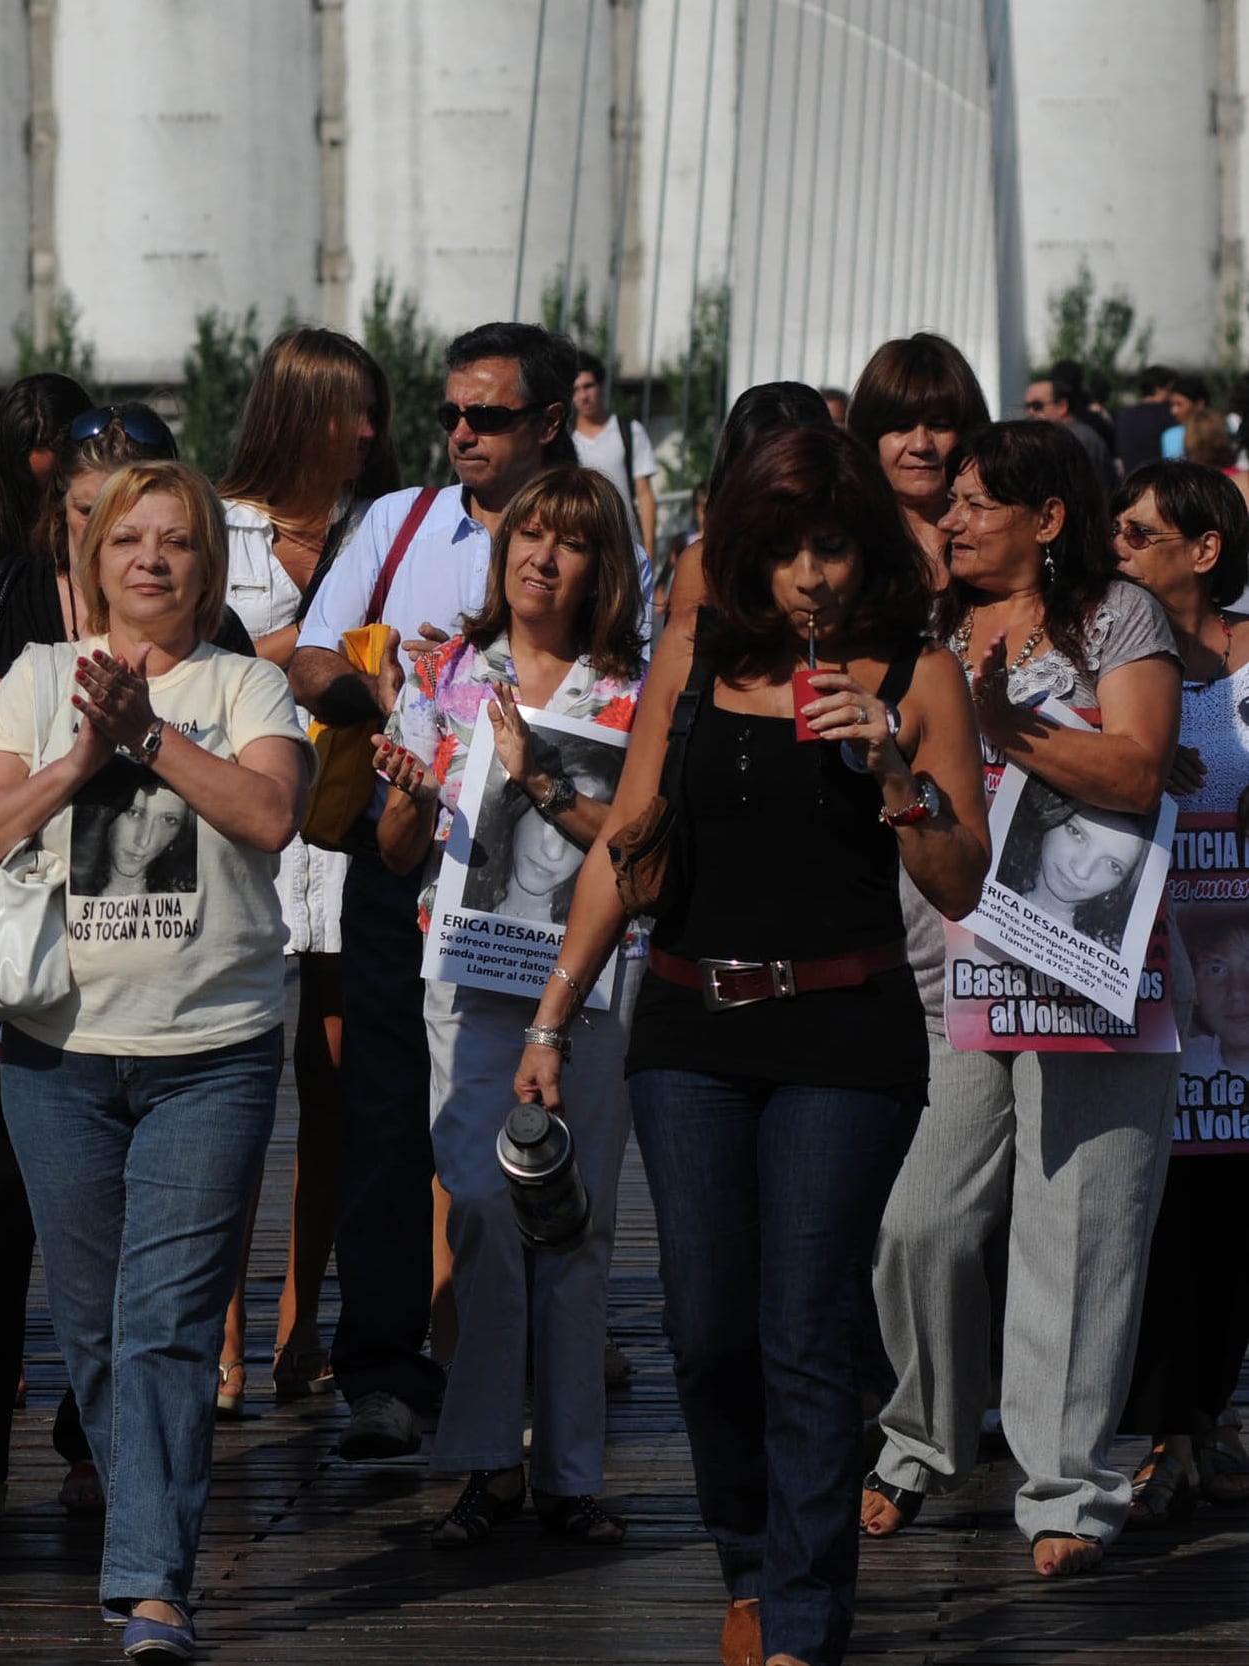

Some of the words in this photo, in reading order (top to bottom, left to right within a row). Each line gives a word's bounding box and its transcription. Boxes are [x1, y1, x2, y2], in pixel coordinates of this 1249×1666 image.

[82, 900, 94, 920] SI
[100, 899, 138, 920] TOCAN
[142, 898, 151, 918] A
[156, 897, 182, 918] UNA
[68, 920, 91, 941] NOS
[95, 920, 137, 941] TOCAN
[141, 919, 151, 940] A
[154, 917, 199, 939] TODAS
[442, 913, 490, 934] ERICA
[493, 925, 565, 947] DESAPA
[989, 901, 1021, 925] ofrece
[1021, 923, 1081, 961] recompensa
[1082, 957, 1100, 973] por
[1100, 968, 1129, 990] quien
[1022, 905, 1130, 979] DESAPARECIDA
[439, 931, 453, 943] Se
[455, 934, 491, 950] ofrece
[492, 942, 559, 962] recompensa
[439, 945, 475, 960] pueda
[476, 953, 518, 968] aportar
[519, 960, 550, 974] datos
[975, 907, 1007, 929] pueda
[1007, 926, 1045, 951] aportar
[1045, 946, 1074, 967] datos
[1075, 964, 1102, 985] sobre
[998, 930, 1037, 956] Llamar
[1034, 952, 1044, 962] al
[466, 963, 504, 980] Llamar
[506, 969, 517, 981] al
[518, 973, 549, 987] 4765-
[954, 961, 1027, 998] Basta
[990, 1000, 1016, 1034] al
[1210, 1073, 1245, 1106] de
